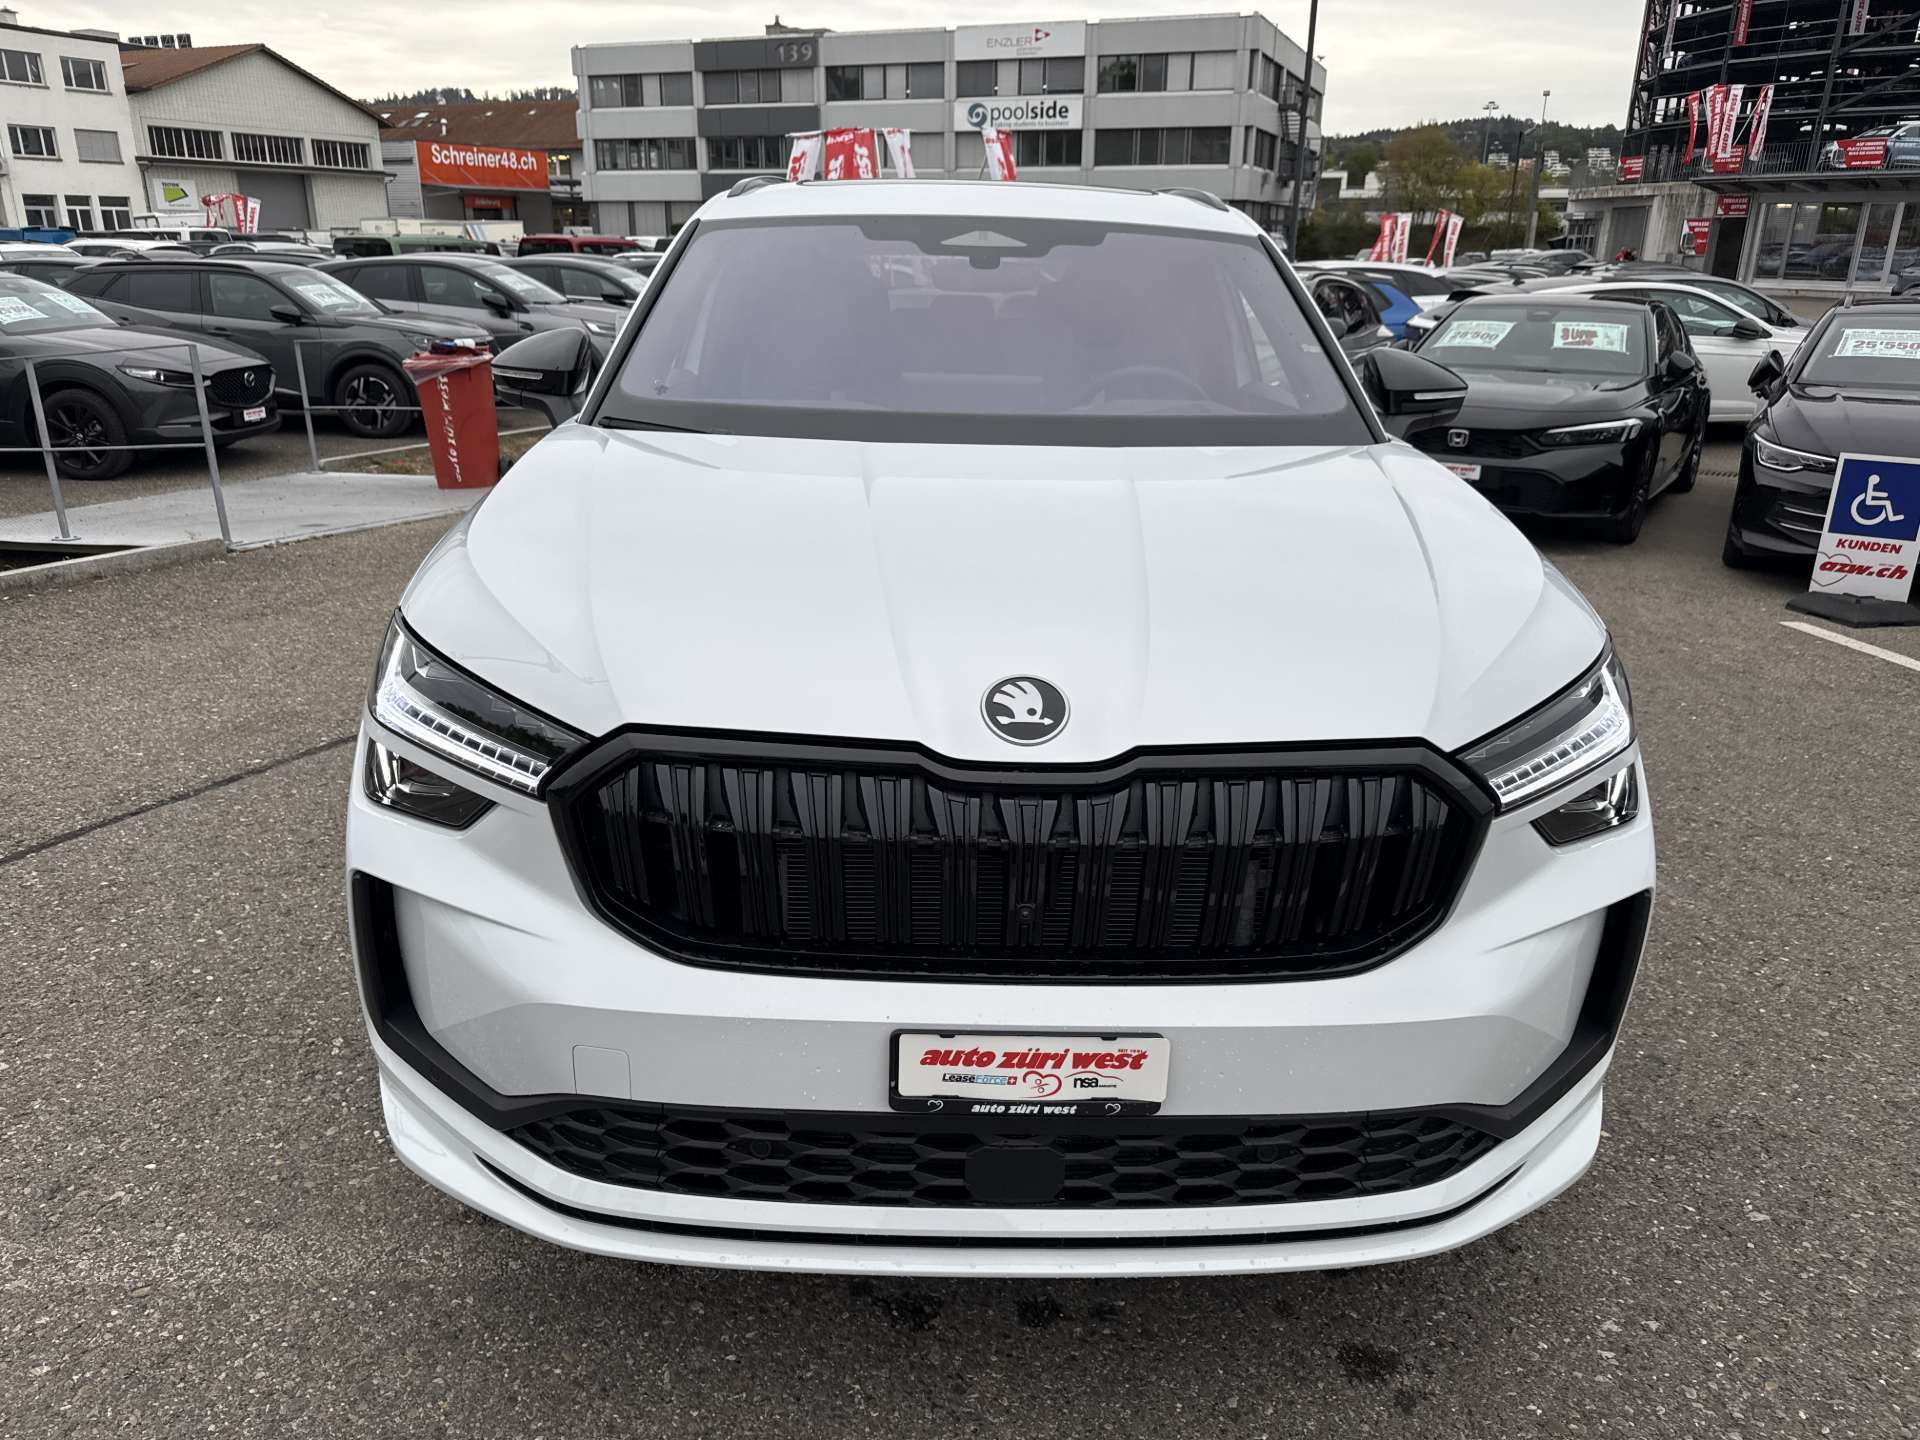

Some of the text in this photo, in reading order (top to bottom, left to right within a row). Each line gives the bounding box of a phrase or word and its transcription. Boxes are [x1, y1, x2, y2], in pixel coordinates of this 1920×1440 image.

[776, 43, 812, 62] 139
[990, 100, 1069, 127] poolside
[431, 144, 537, 170] Schreiner48.ch
[1836, 538, 1903, 554] KUNDEN
[1819, 561, 1908, 579] azw.ch
[919, 1047, 1148, 1070] auto züri west
[971, 1103, 1077, 1114] auto züri west
